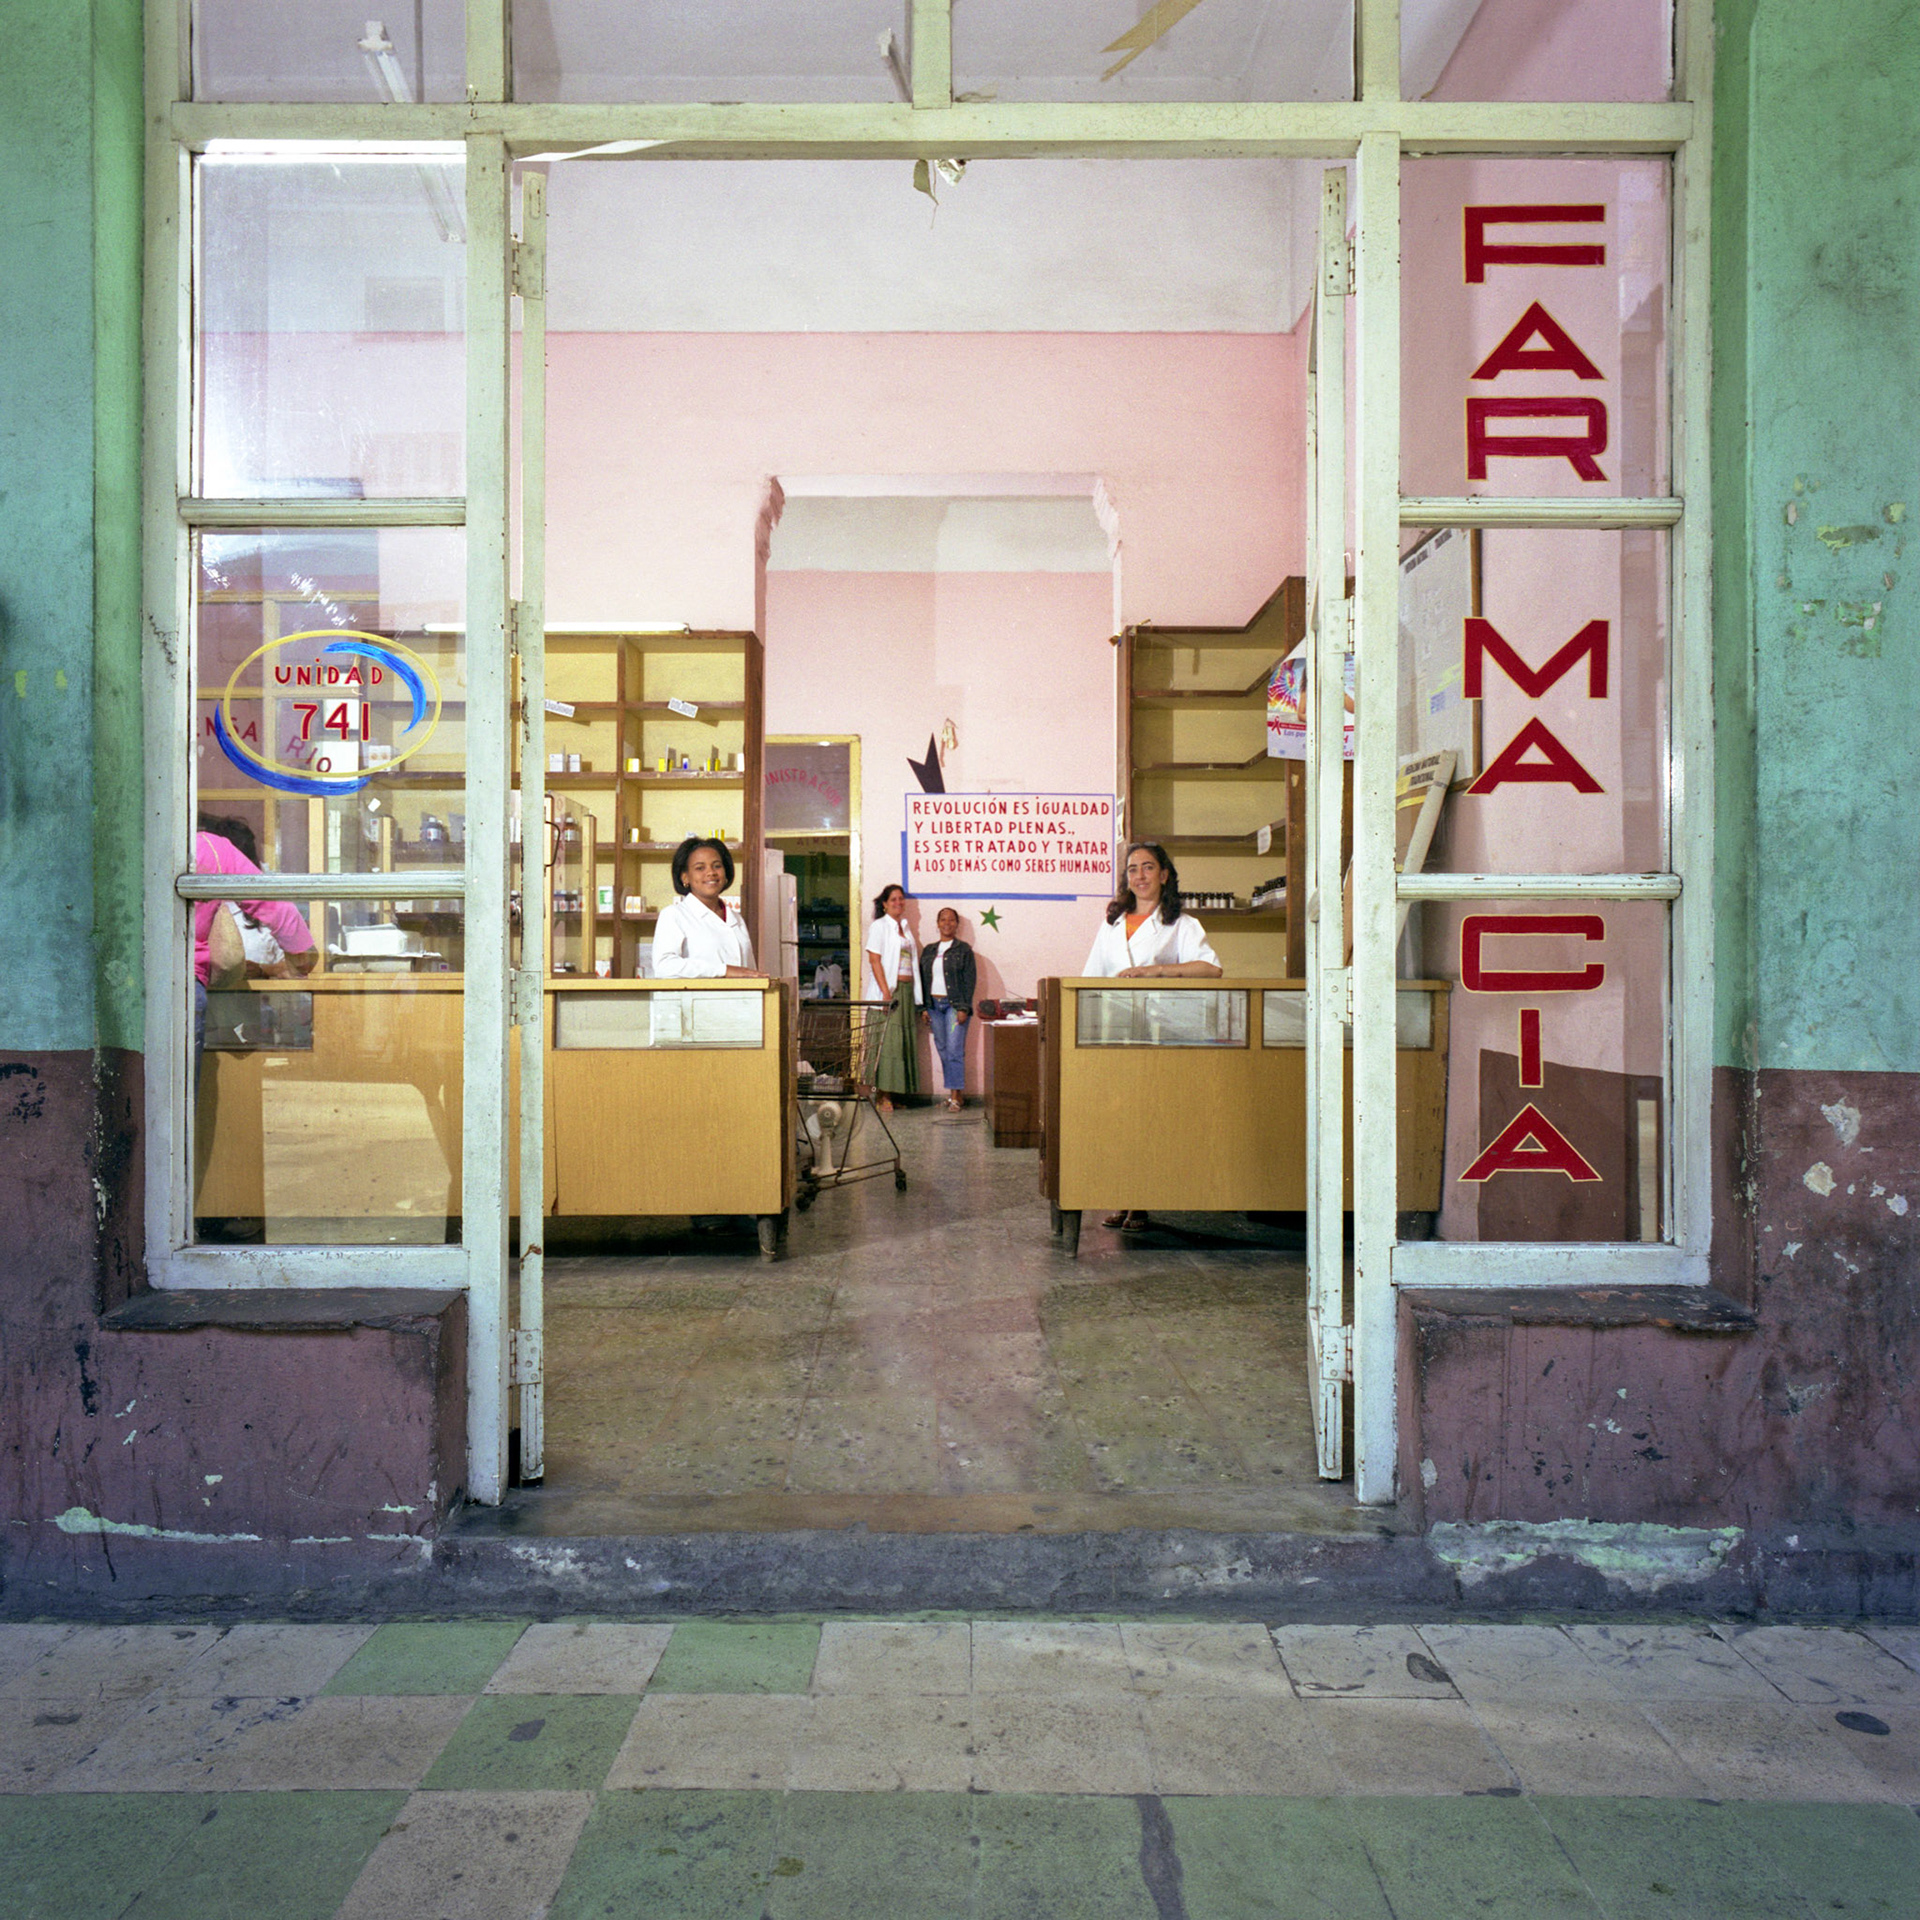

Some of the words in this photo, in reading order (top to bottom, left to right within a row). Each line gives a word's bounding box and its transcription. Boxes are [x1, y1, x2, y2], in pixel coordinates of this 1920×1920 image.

[274, 657, 383, 686] UNIDAD
[1457, 203, 1610, 1183] FARMACIA
[292, 701, 371, 742] 741
[912, 797, 1007, 815] REVOLUCIÓN
[1012, 801, 1031, 815] ES
[1034, 796, 1110, 816] IGUALDAD
[914, 821, 924, 834] Y
[931, 821, 1004, 834] LIBERTAD
[914, 840, 930, 853] ES
[934, 840, 960, 853] SER
[964, 840, 1038, 854] TRATADO
[1041, 840, 1051, 854] Y
[1056, 840, 1109, 859] TRATAR
[913, 858, 922, 872] A
[925, 858, 946, 873] LOS
[990, 858, 1022, 872] COMO
[1024, 858, 1056, 873] SERES
[1059, 858, 1112, 874] HUMANOS
